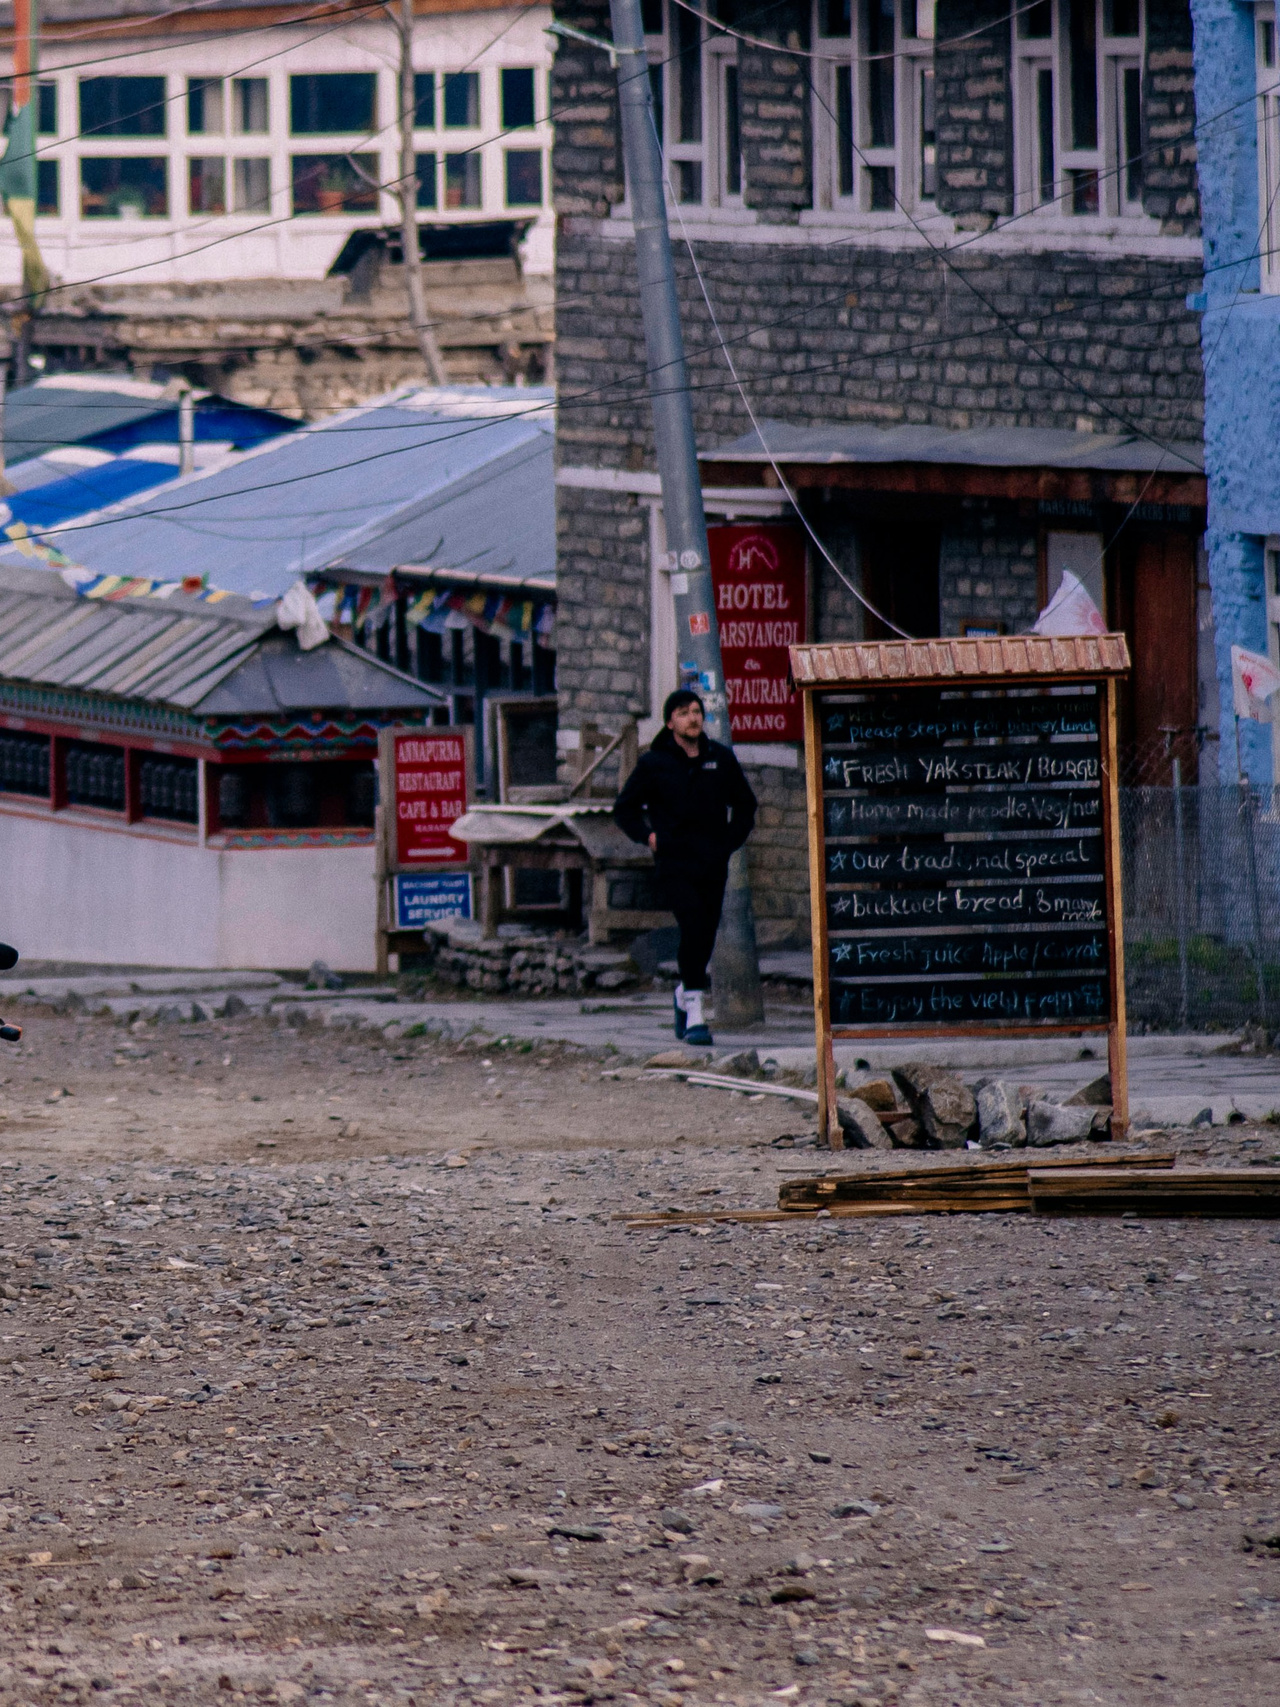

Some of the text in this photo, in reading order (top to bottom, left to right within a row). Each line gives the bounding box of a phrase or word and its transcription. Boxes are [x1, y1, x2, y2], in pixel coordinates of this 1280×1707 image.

[718, 583, 789, 610] HOTEL
[719, 621, 798, 649] ARSYANGDI
[726, 677, 796, 706] STAURAN
[731, 714, 786, 731] ANANG
[849, 723, 903, 744] please
[951, 718, 968, 732] in
[398, 740, 462, 763] ANNAPURNA
[398, 771, 462, 793] RESTAURANT
[842, 756, 908, 787] FRESH
[919, 756, 959, 783] YAK
[961, 758, 1021, 781] STEAK
[398, 801, 427, 820] CAFE
[441, 799, 463, 819] BAR
[852, 798, 900, 821] Home
[852, 850, 891, 871] Our
[1015, 839, 1091, 878] special
[404, 893, 465, 907] LAUNDRY
[408, 907, 463, 921] SERVICE
[857, 942, 917, 965] Fresh
[982, 941, 1028, 970] Apple
[930, 985, 964, 1010] the
